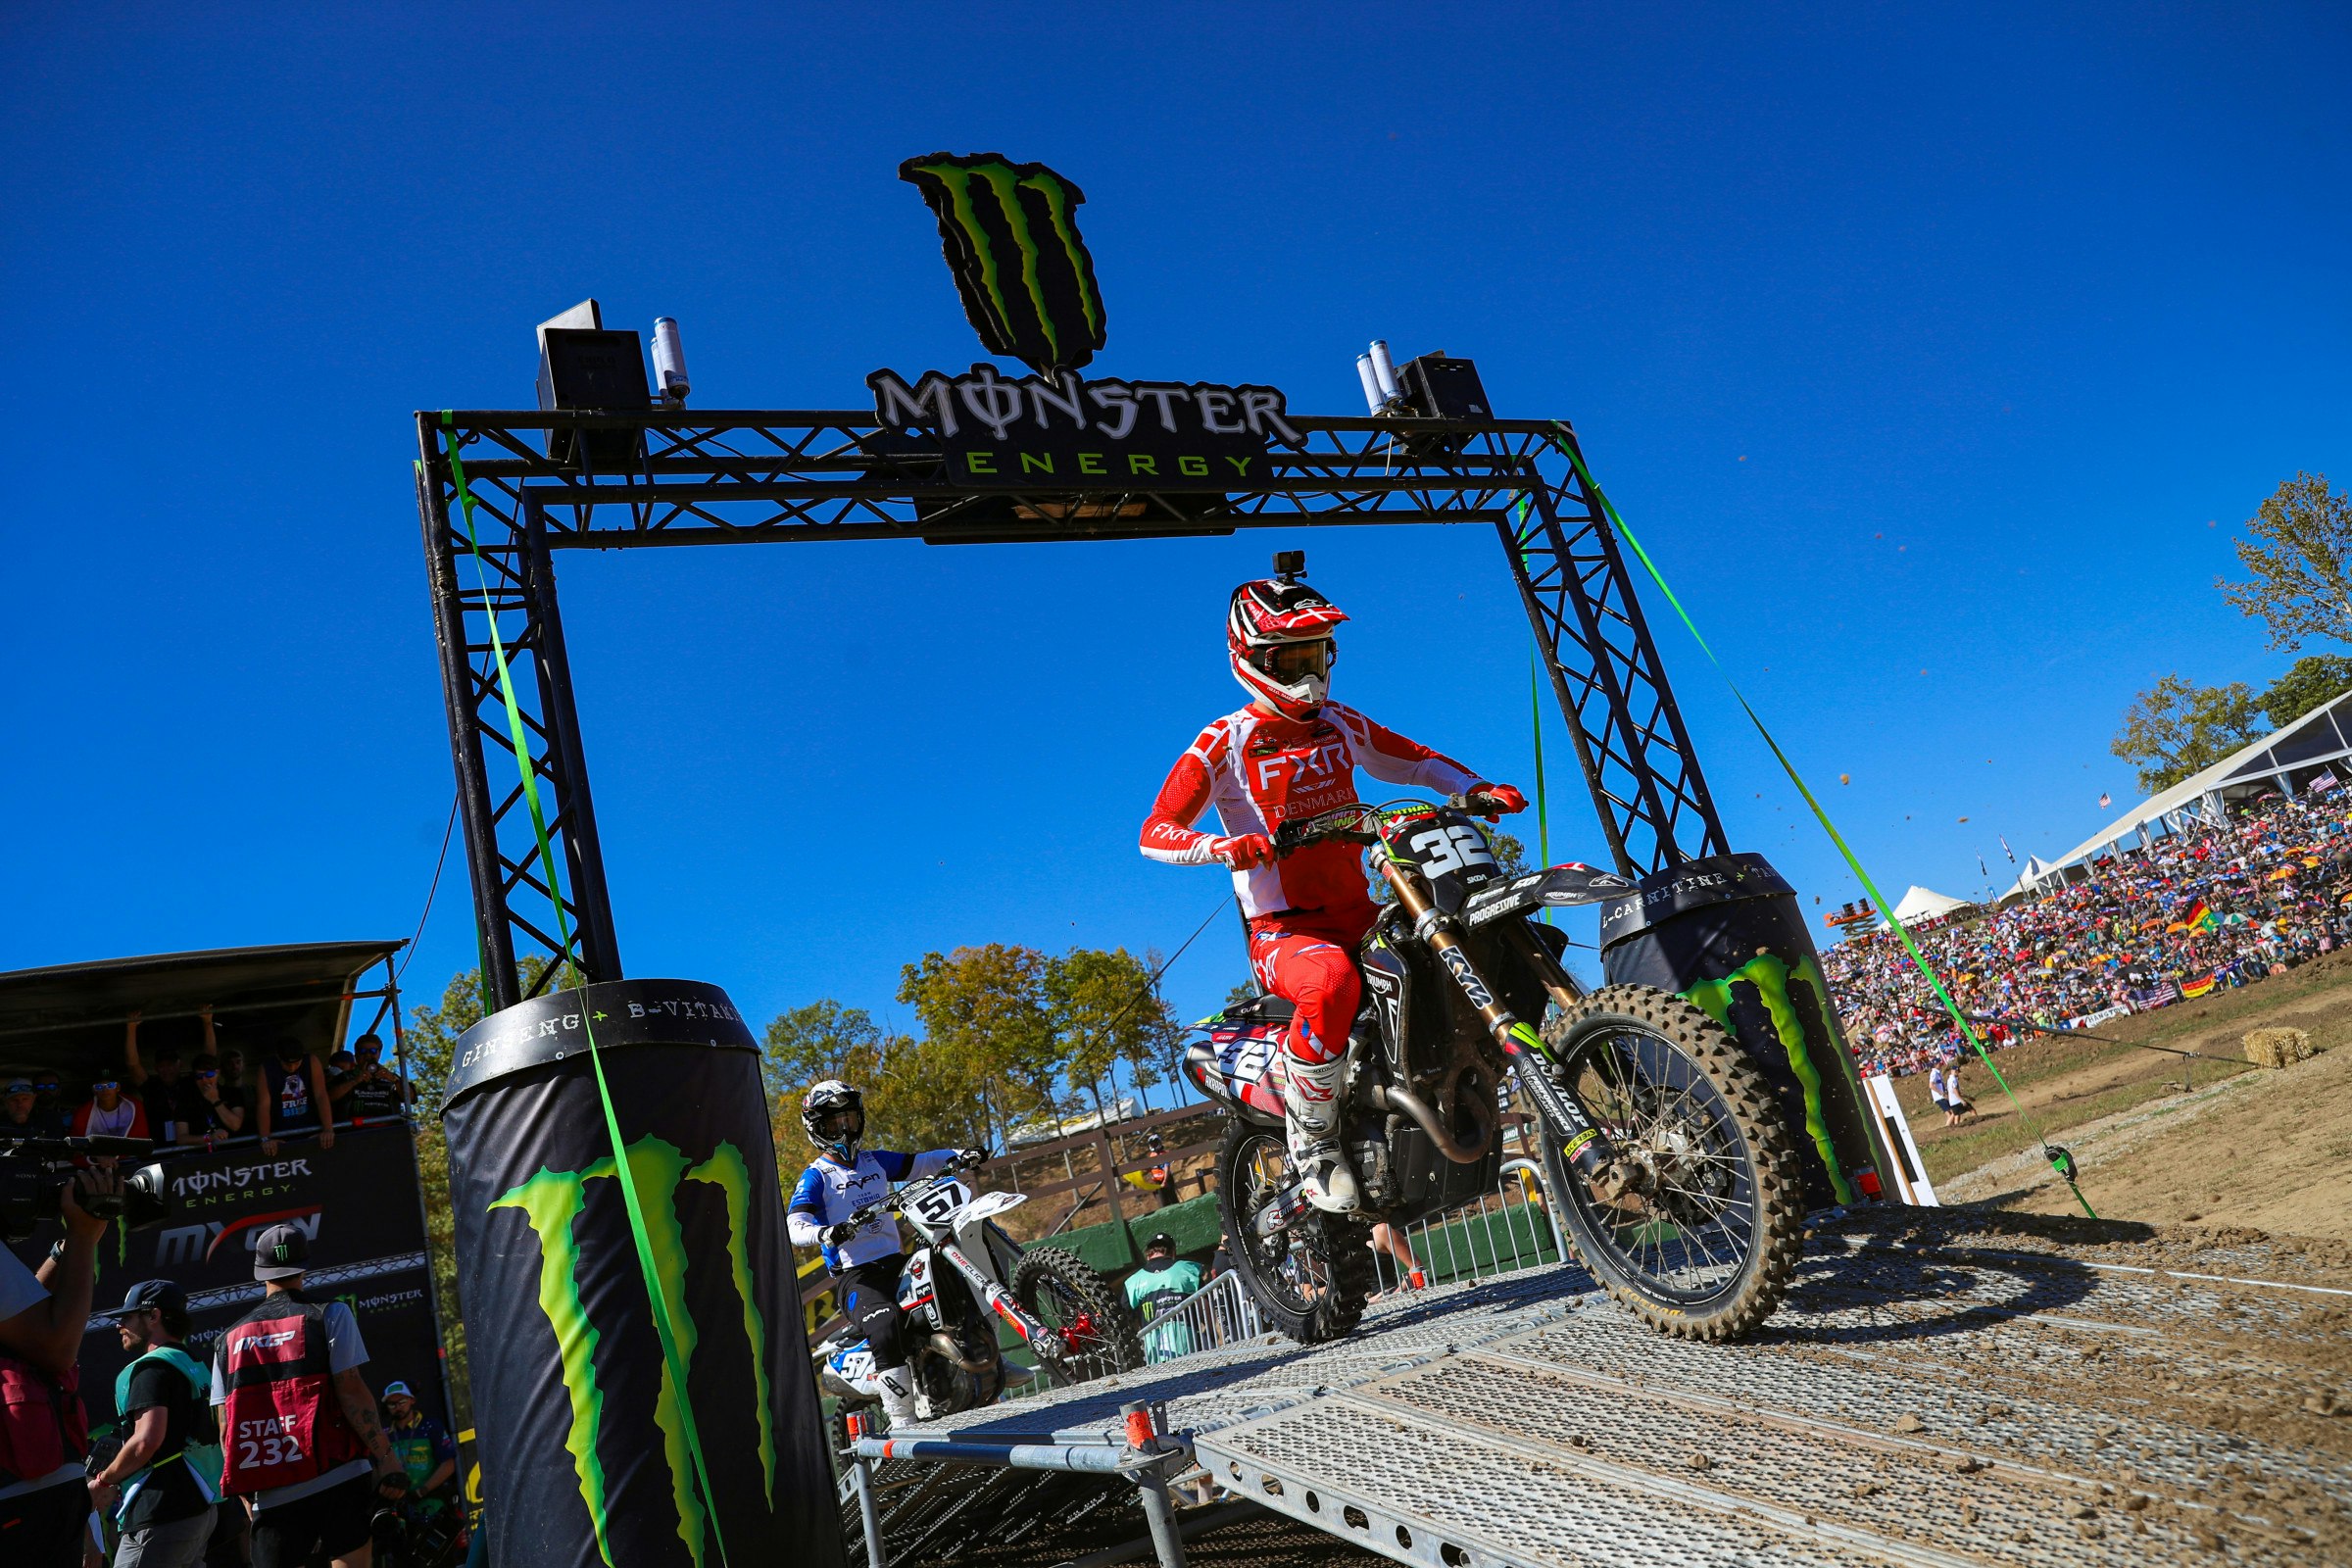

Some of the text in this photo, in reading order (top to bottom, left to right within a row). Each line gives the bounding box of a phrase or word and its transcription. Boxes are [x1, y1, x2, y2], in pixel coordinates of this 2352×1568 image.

[877, 369, 1303, 440] MONSTER
[966, 451, 1252, 477] ENERGY
[1257, 742, 1350, 791] FXR
[1273, 787, 1355, 818] DENMARK
[1151, 822, 1194, 842] FXR
[1409, 825, 1495, 880] 32
[1510, 874, 1543, 891] FXR
[1544, 891, 1577, 900] TRIUMPH
[1469, 891, 1524, 927] PROGRESSIVE
[1602, 872, 1728, 928] L-CARNITINE
[1365, 973, 1394, 992] TRIUMPH
[1438, 945, 1494, 1010] KYB
[462, 1012, 580, 1068] GINSENG
[1216, 1039, 1277, 1084] 32
[1530, 1075, 1573, 1132] PERFORMANCE
[1566, 1130, 1596, 1154] ACERBIS
[185, 1184, 292, 1208] ENERGY
[852, 1194, 881, 1207] ESTONIA
[915, 1183, 964, 1224] 57
[1266, 1197, 1302, 1230] RENTHAL
[951, 1251, 988, 1287] ONECLICK
[232, 1330, 296, 1355] MXGP
[239, 1414, 297, 1439] STAFF
[238, 1435, 303, 1470] 232
